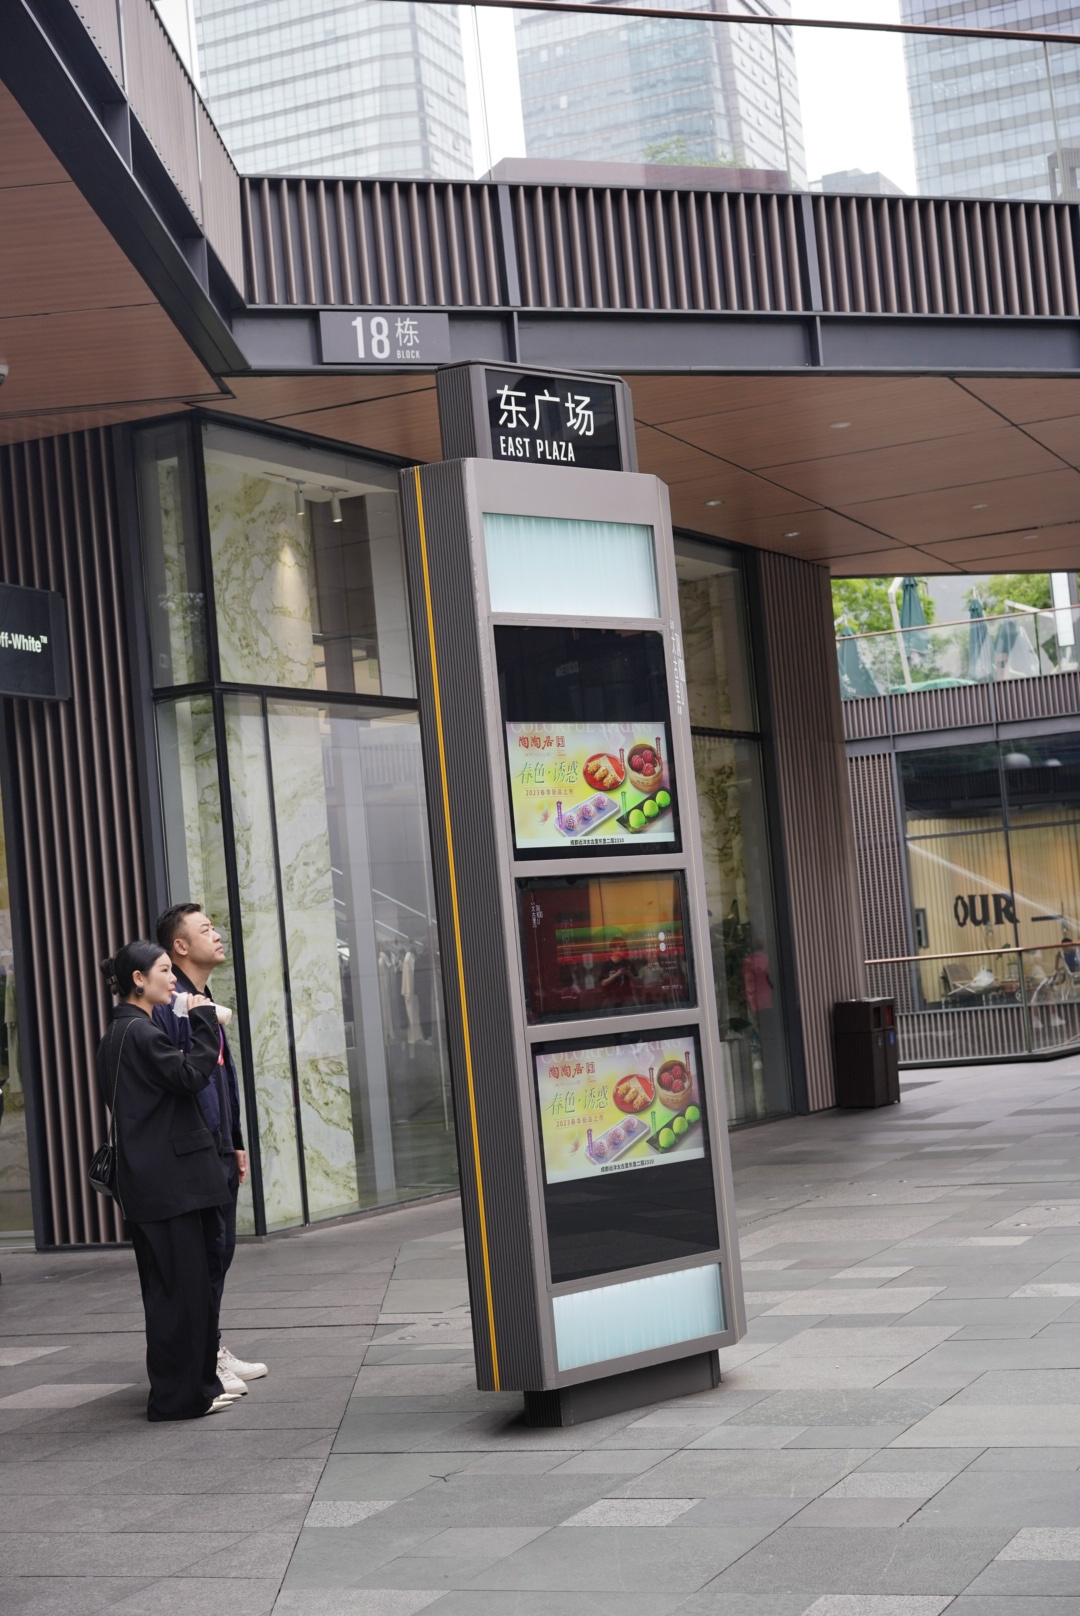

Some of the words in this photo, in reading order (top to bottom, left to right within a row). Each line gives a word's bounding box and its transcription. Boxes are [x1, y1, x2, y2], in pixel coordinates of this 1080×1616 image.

[396, 349, 421, 359] BLOCK
[496, 384, 595, 436] 东广场
[500, 435, 530, 458] EAST
[536, 439, 576, 462] PLAZA
[0, 631, 48, 653] ff-White™
[954, 894, 1020, 928] OUR
